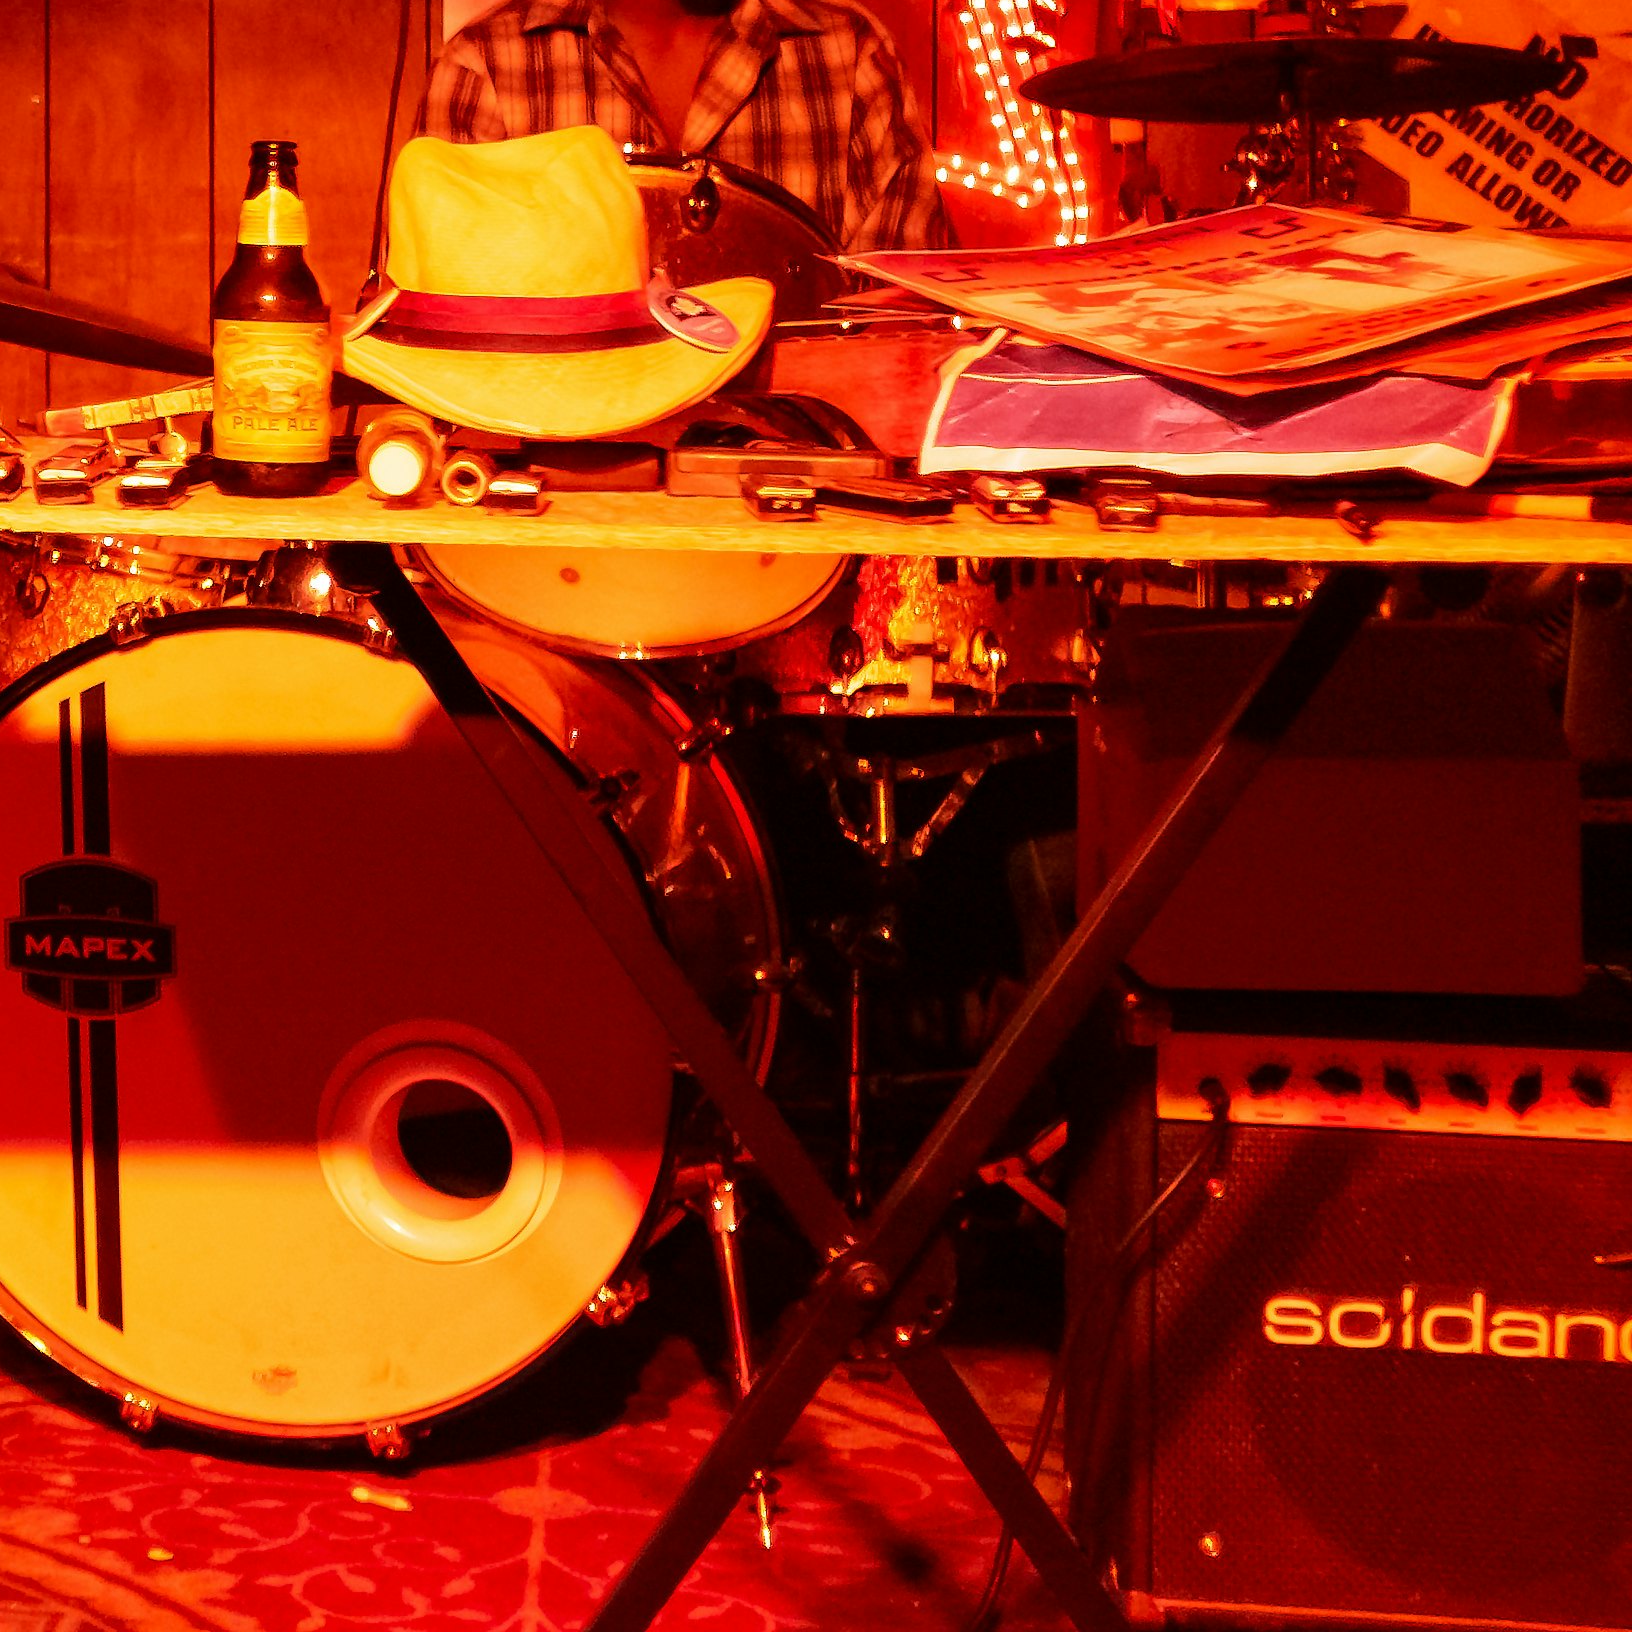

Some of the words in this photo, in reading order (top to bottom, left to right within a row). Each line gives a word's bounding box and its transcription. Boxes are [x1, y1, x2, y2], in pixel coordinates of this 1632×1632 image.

[1442, 106, 1535, 173] MING
[1532, 158, 1582, 203] OR
[1504, 96, 1632, 188] HORIZED
[1445, 151, 1572, 230] ALLOW
[232, 415, 280, 432] PALE
[287, 415, 319, 432] ALE
[24, 934, 157, 963] MAPEX
[1263, 1284, 1632, 1364] soldan
